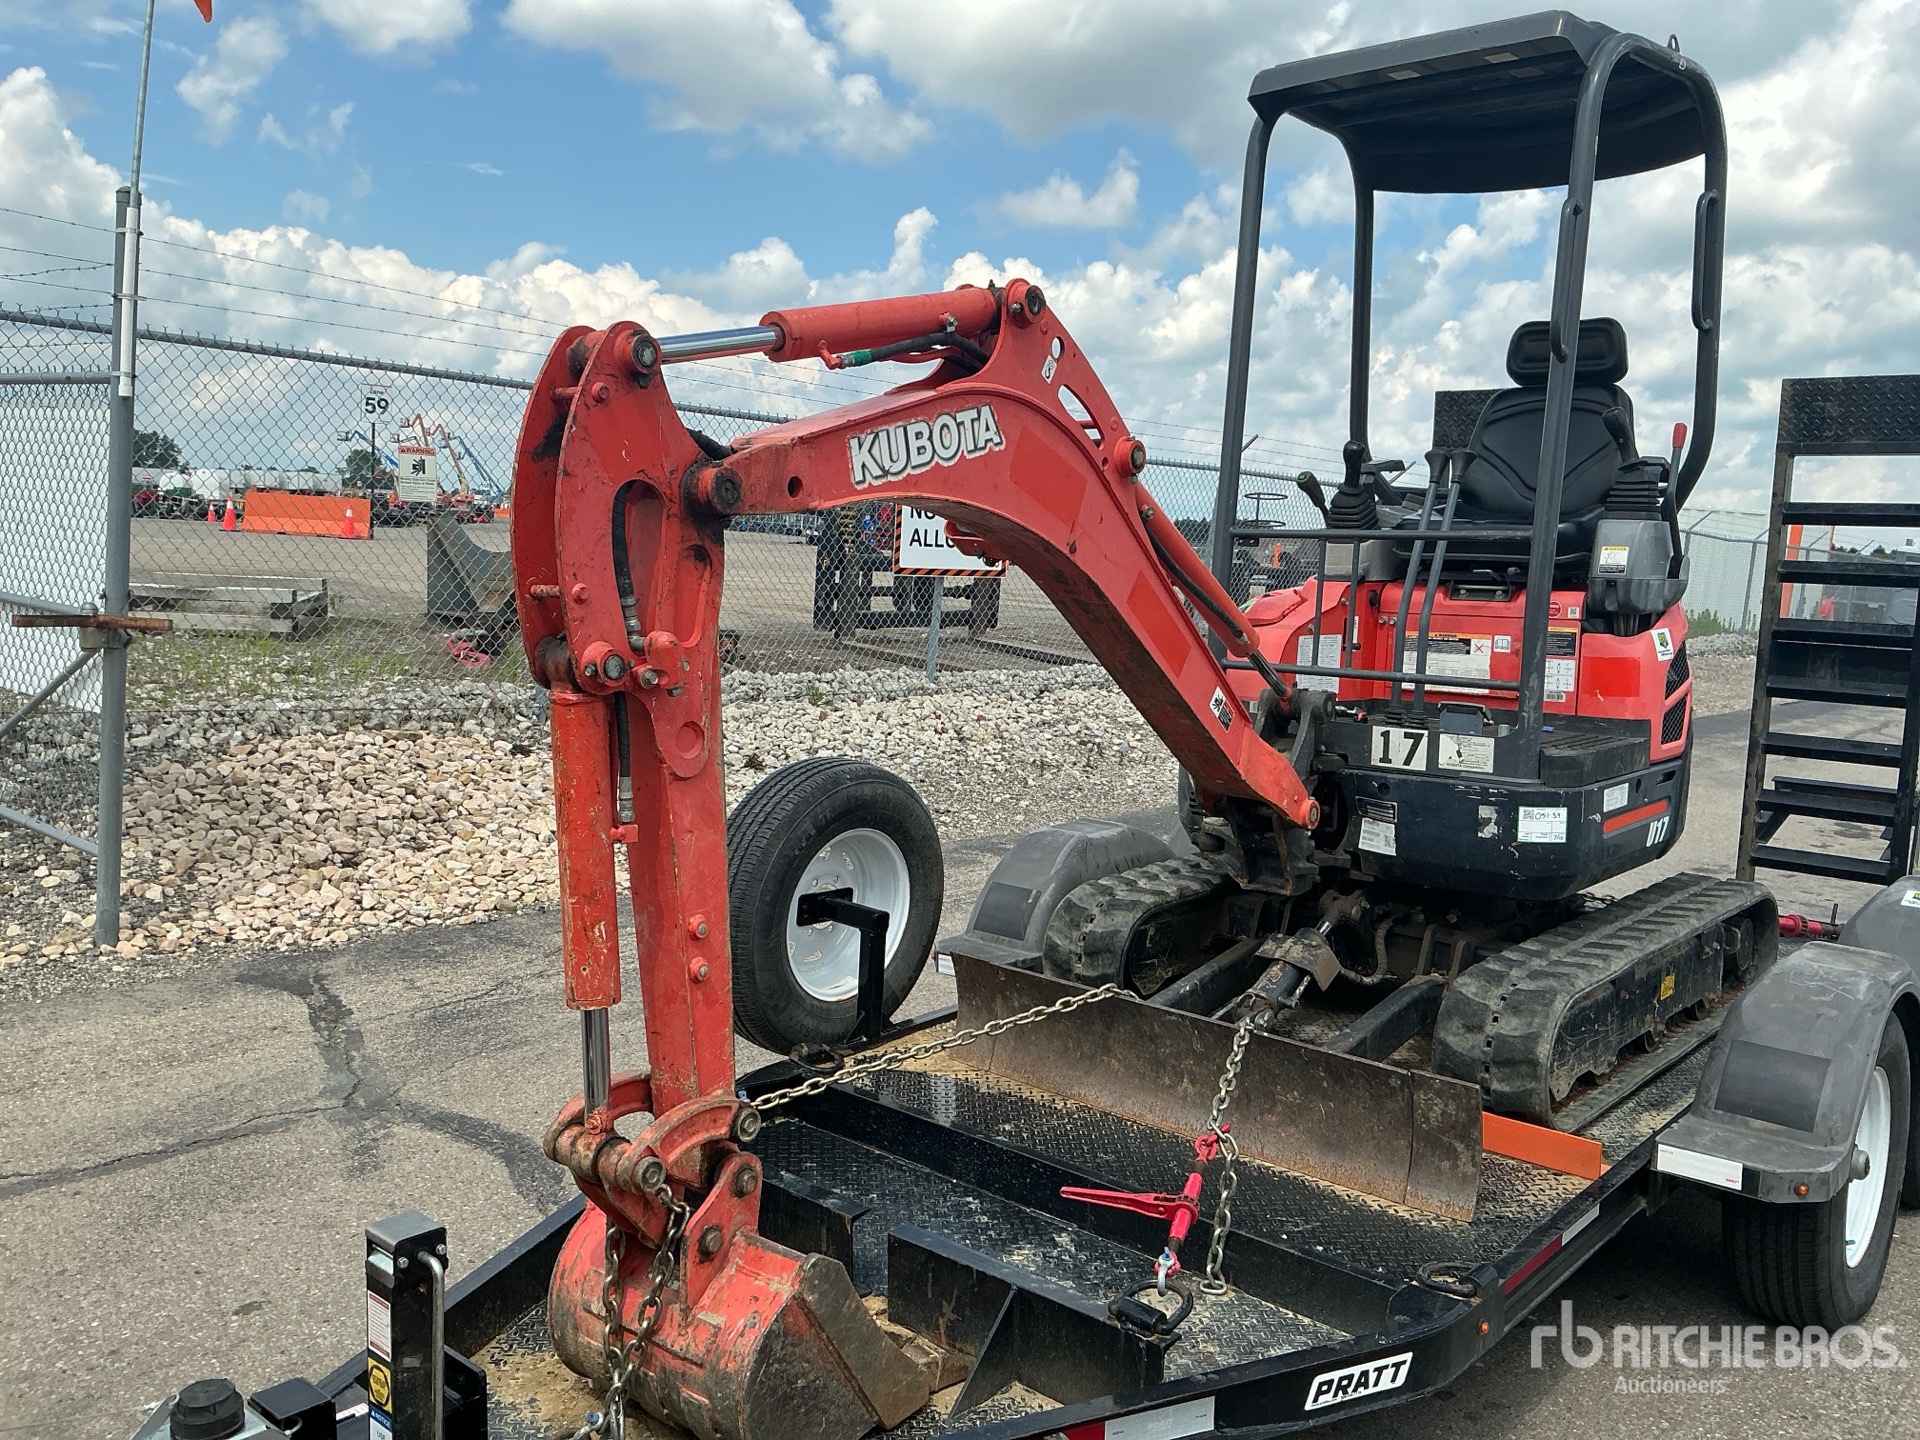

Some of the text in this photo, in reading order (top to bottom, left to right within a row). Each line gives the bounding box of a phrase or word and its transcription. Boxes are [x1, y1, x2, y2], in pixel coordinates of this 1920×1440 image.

[364, 397, 389, 415] 59
[406, 447, 435, 455] WARNING
[849, 404, 1004, 484] KUBOTA
[1379, 729, 1425, 766] 17
[1646, 816, 1670, 847] U17
[1311, 1359, 1408, 1404] PRATT
